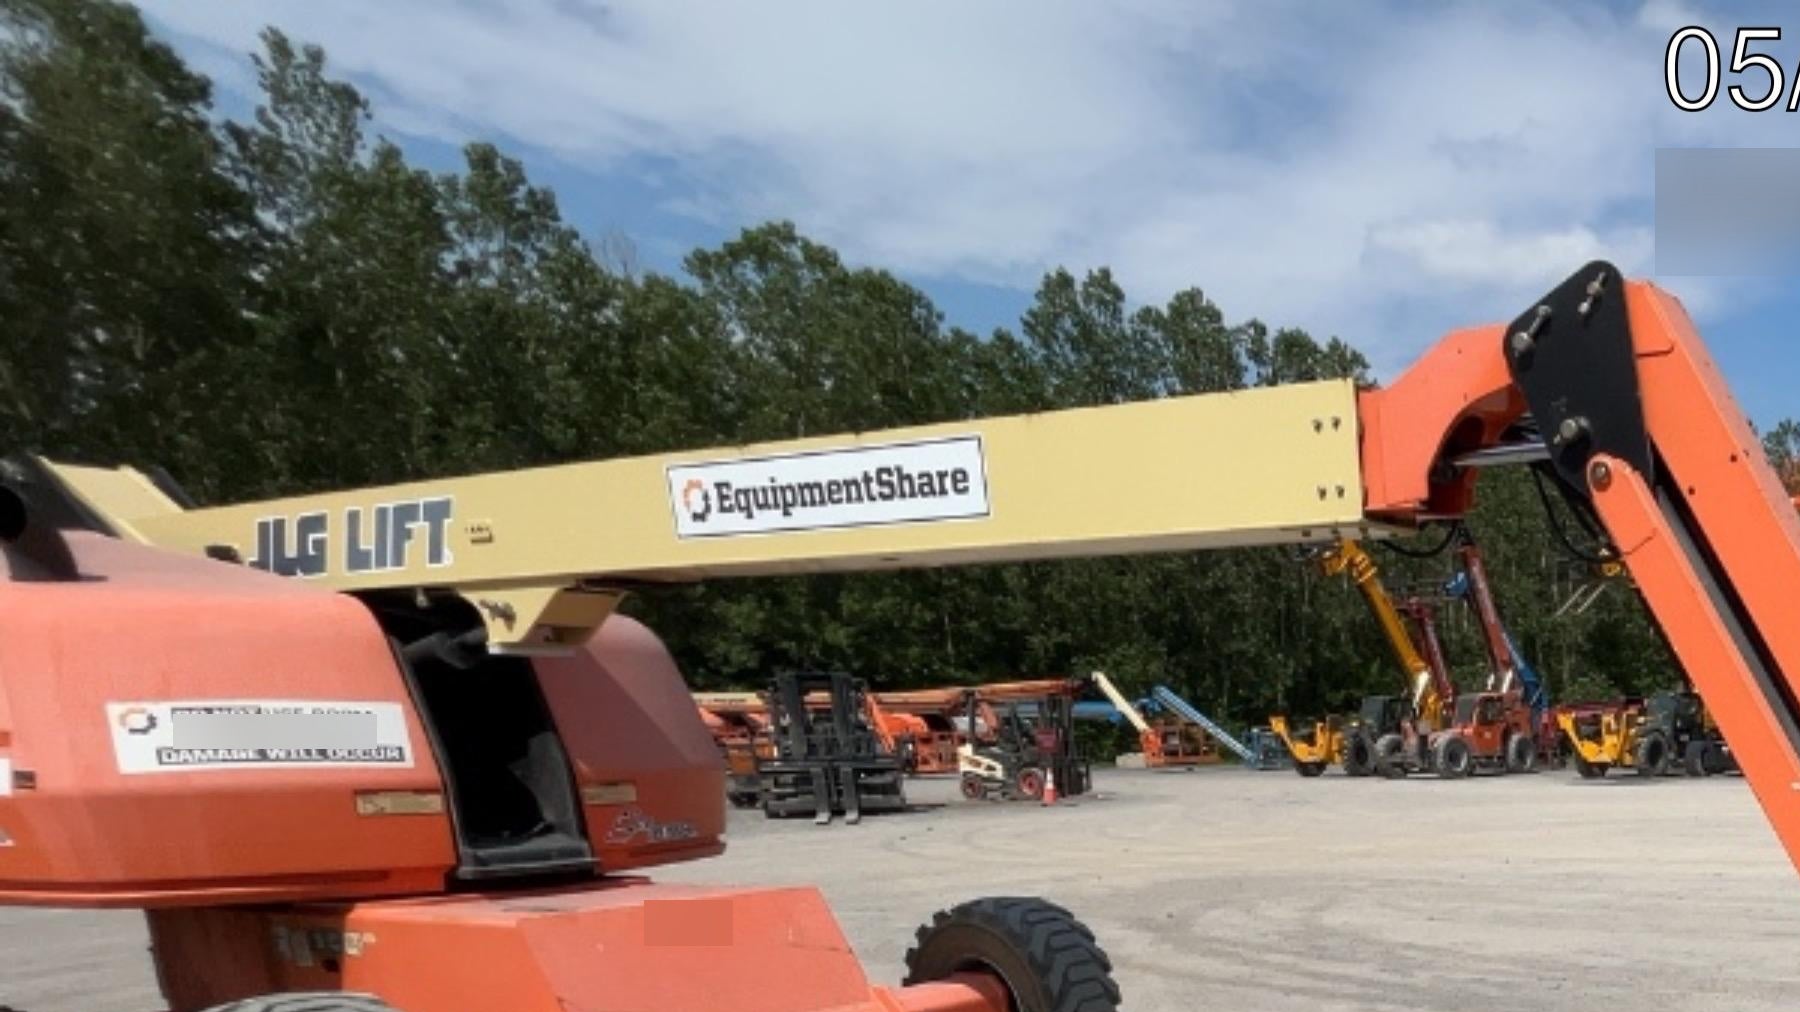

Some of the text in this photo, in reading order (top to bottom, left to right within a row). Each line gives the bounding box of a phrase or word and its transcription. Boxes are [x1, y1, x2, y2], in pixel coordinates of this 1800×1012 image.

[713, 464, 970, 519] EquipmentShare
[248, 495, 454, 579] JLG LIFT
